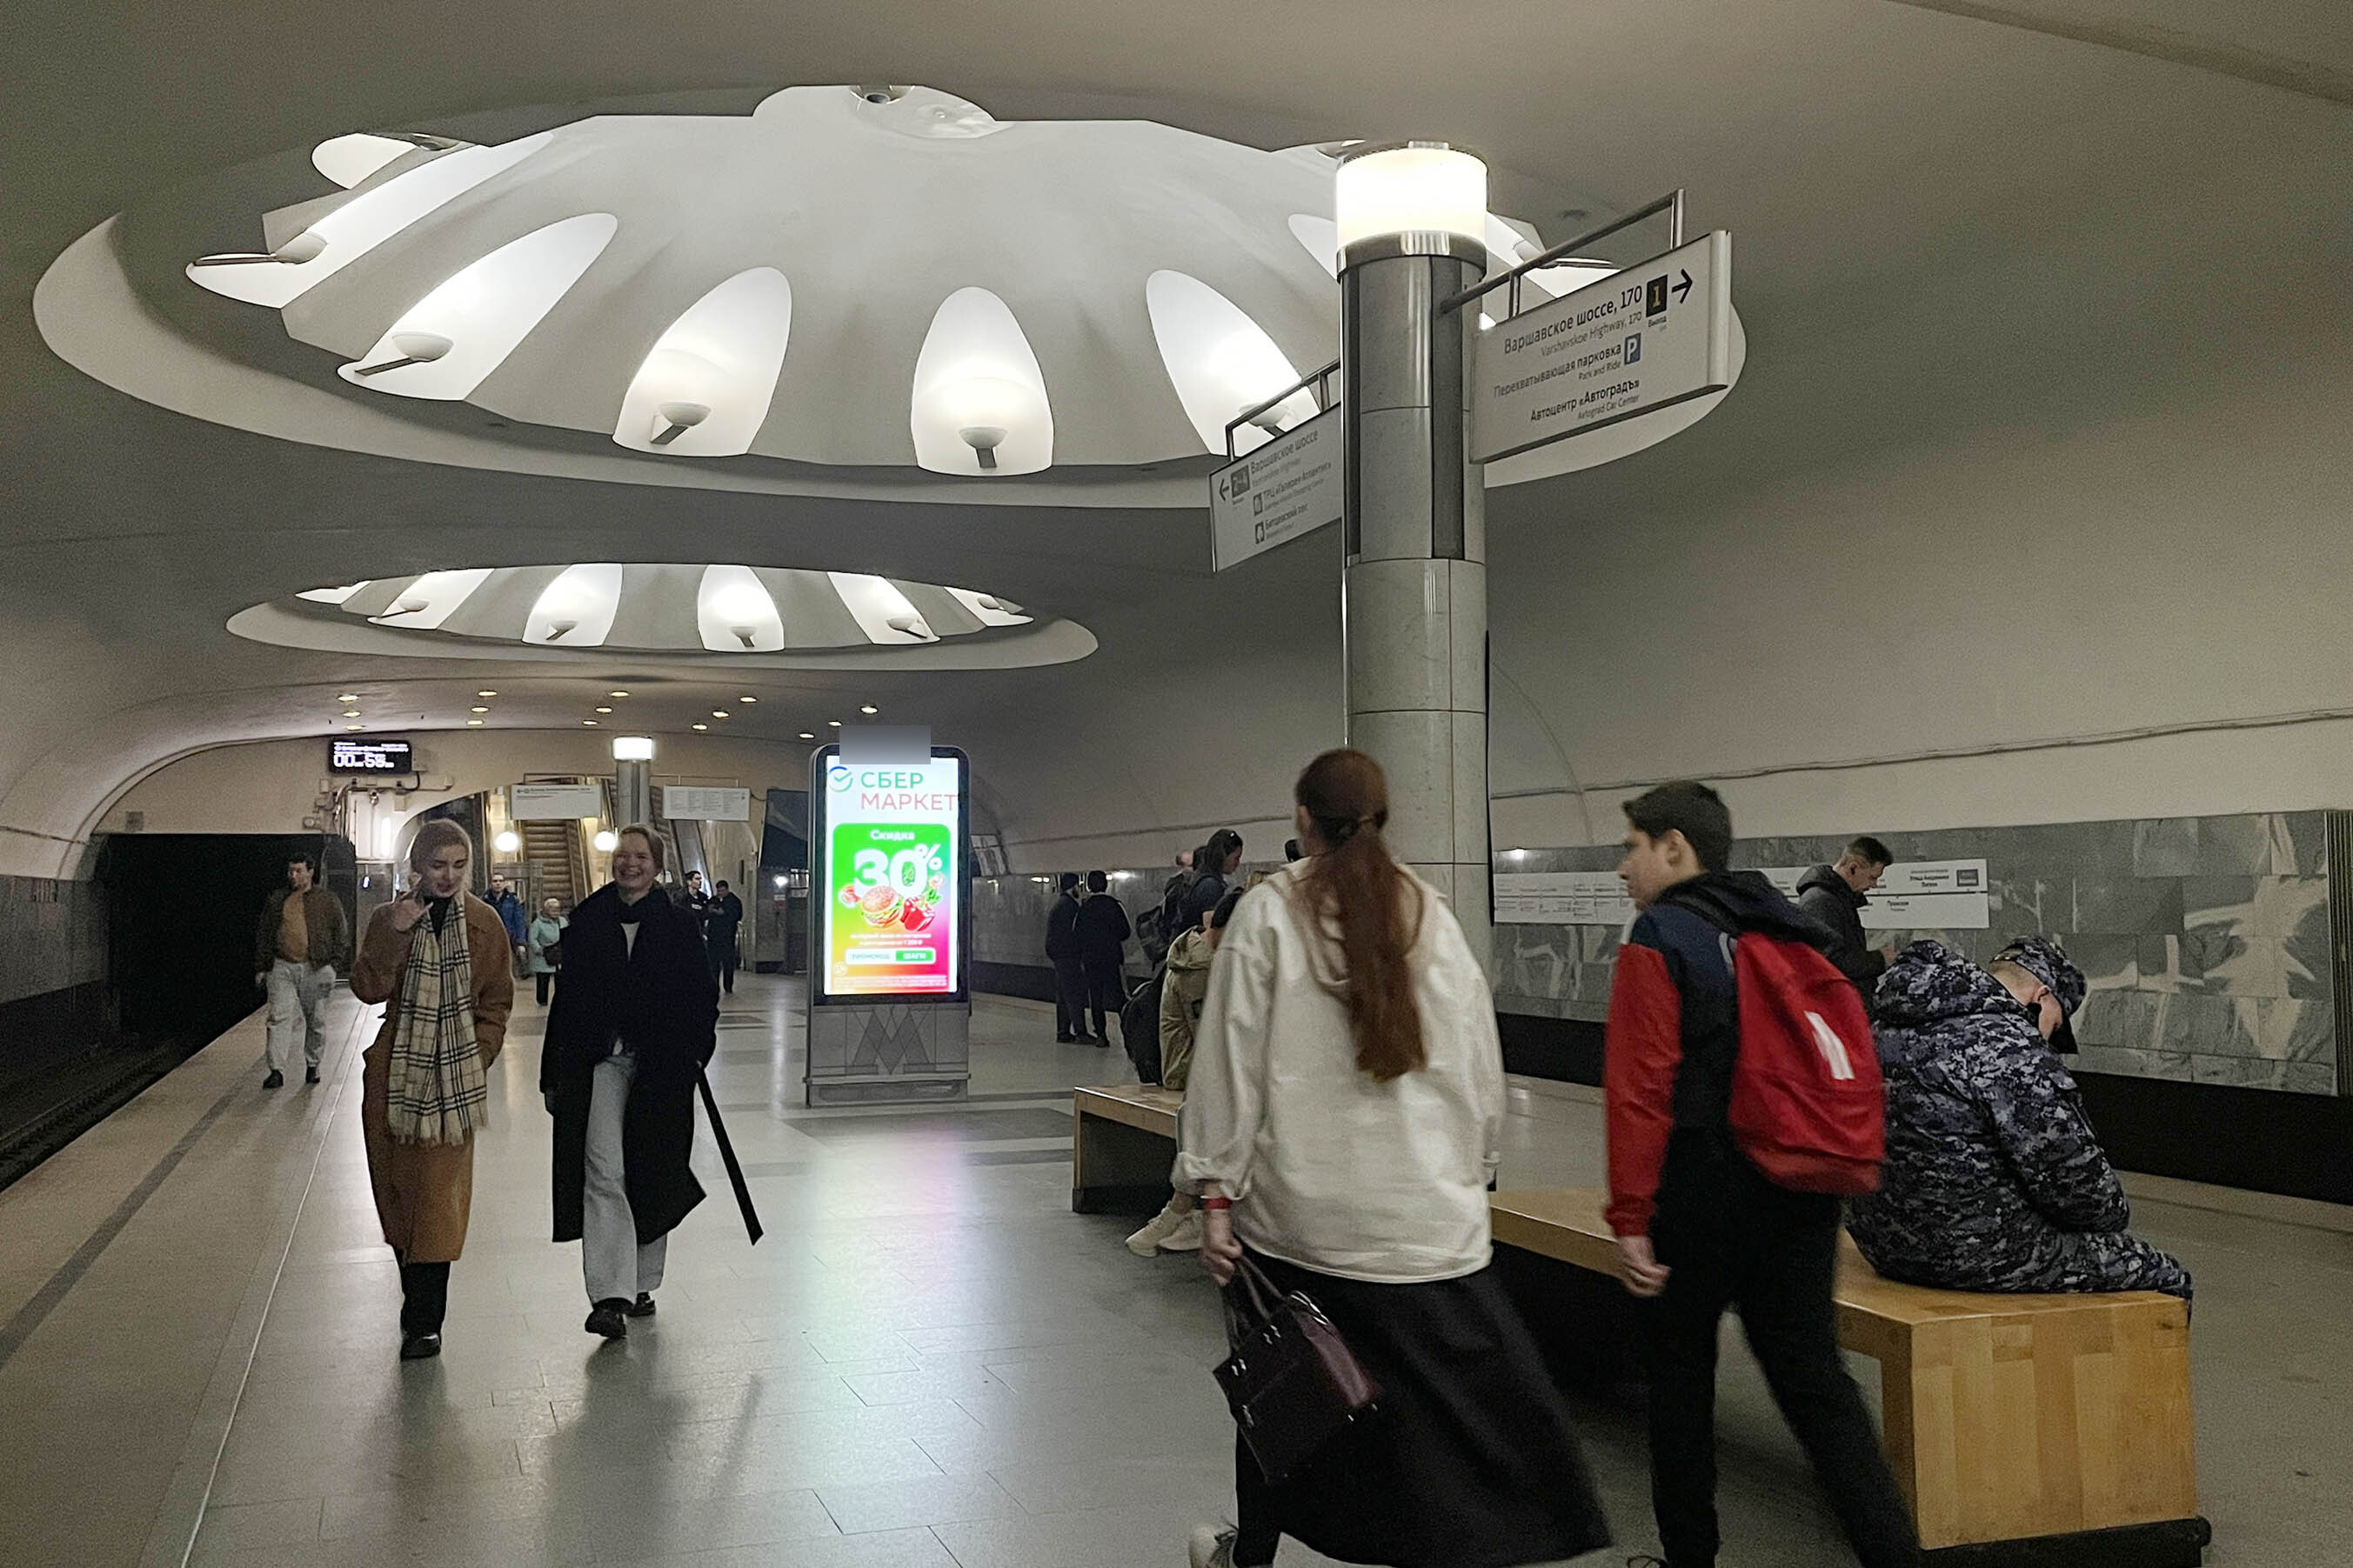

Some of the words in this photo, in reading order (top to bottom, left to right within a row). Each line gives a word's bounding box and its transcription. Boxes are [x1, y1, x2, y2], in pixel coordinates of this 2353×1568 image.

[1653, 285, 1661, 307] 1
[1504, 317, 1574, 355] Варшавское
[1576, 301, 1617, 326] шоссе,
[1621, 285, 1642, 309] 170
[1628, 311, 1642, 325] 170
[1627, 337, 1637, 362] P
[1494, 360, 1575, 398] Перехватывающая
[1576, 344, 1621, 370] парковка
[1530, 399, 1577, 423] Автоцентр
[860, 771, 923, 789] СБЕР
[860, 792, 959, 811] МАРКЕТ
[870, 830, 915, 842] Скидка
